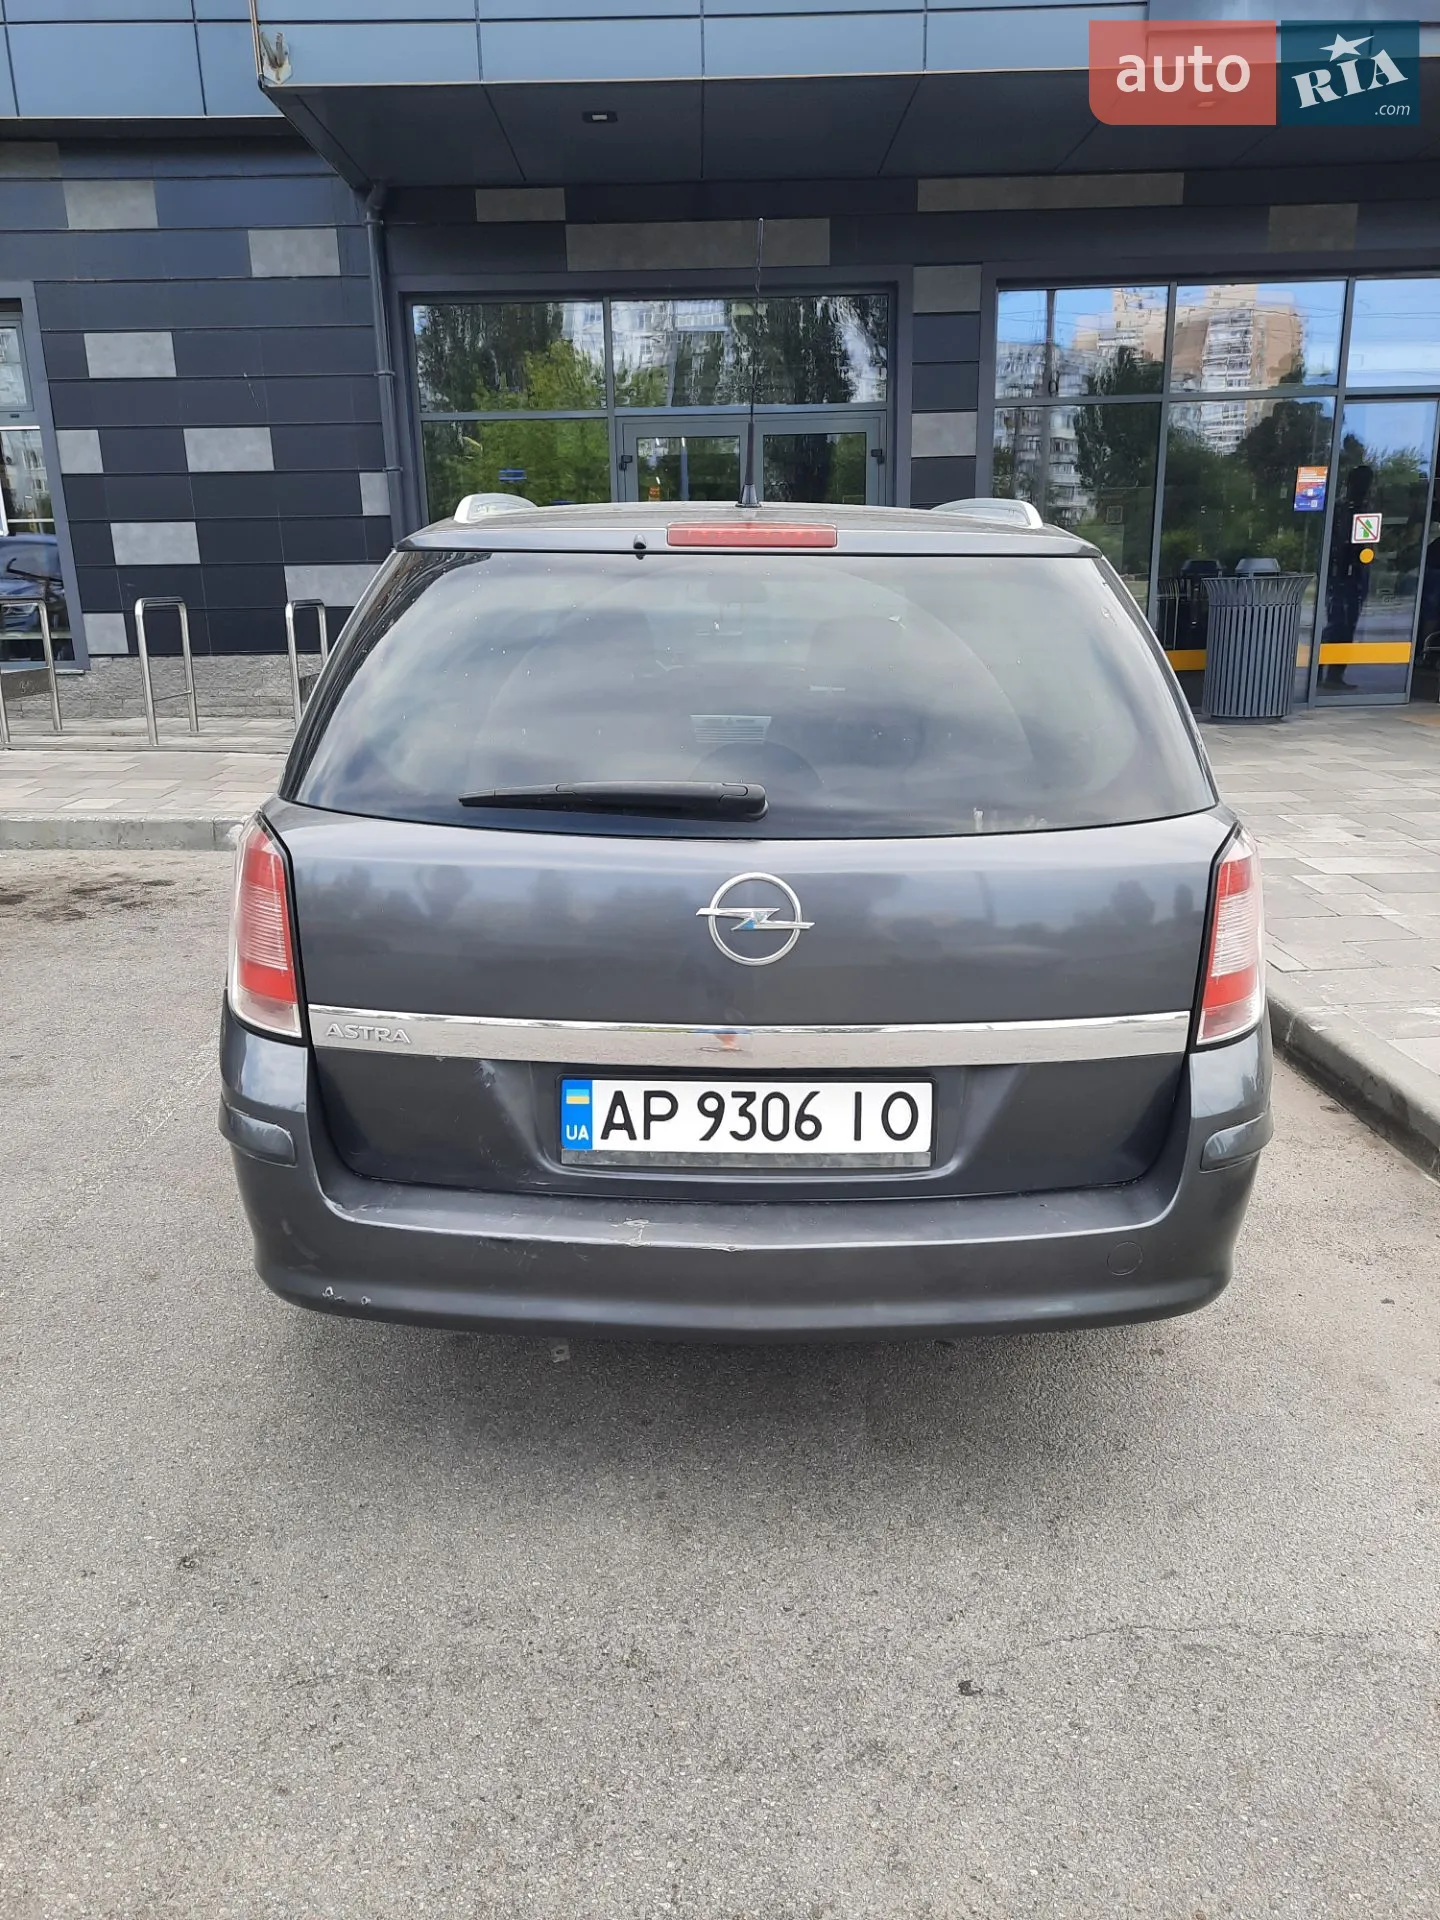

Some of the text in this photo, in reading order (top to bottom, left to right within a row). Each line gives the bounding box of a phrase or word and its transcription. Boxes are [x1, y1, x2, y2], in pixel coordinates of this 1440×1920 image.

[325, 1023, 412, 1044] ASTRA
[600, 1090, 679, 1141] AP
[697, 1090, 823, 1142] 9306
[566, 1124, 589, 1140] UA
